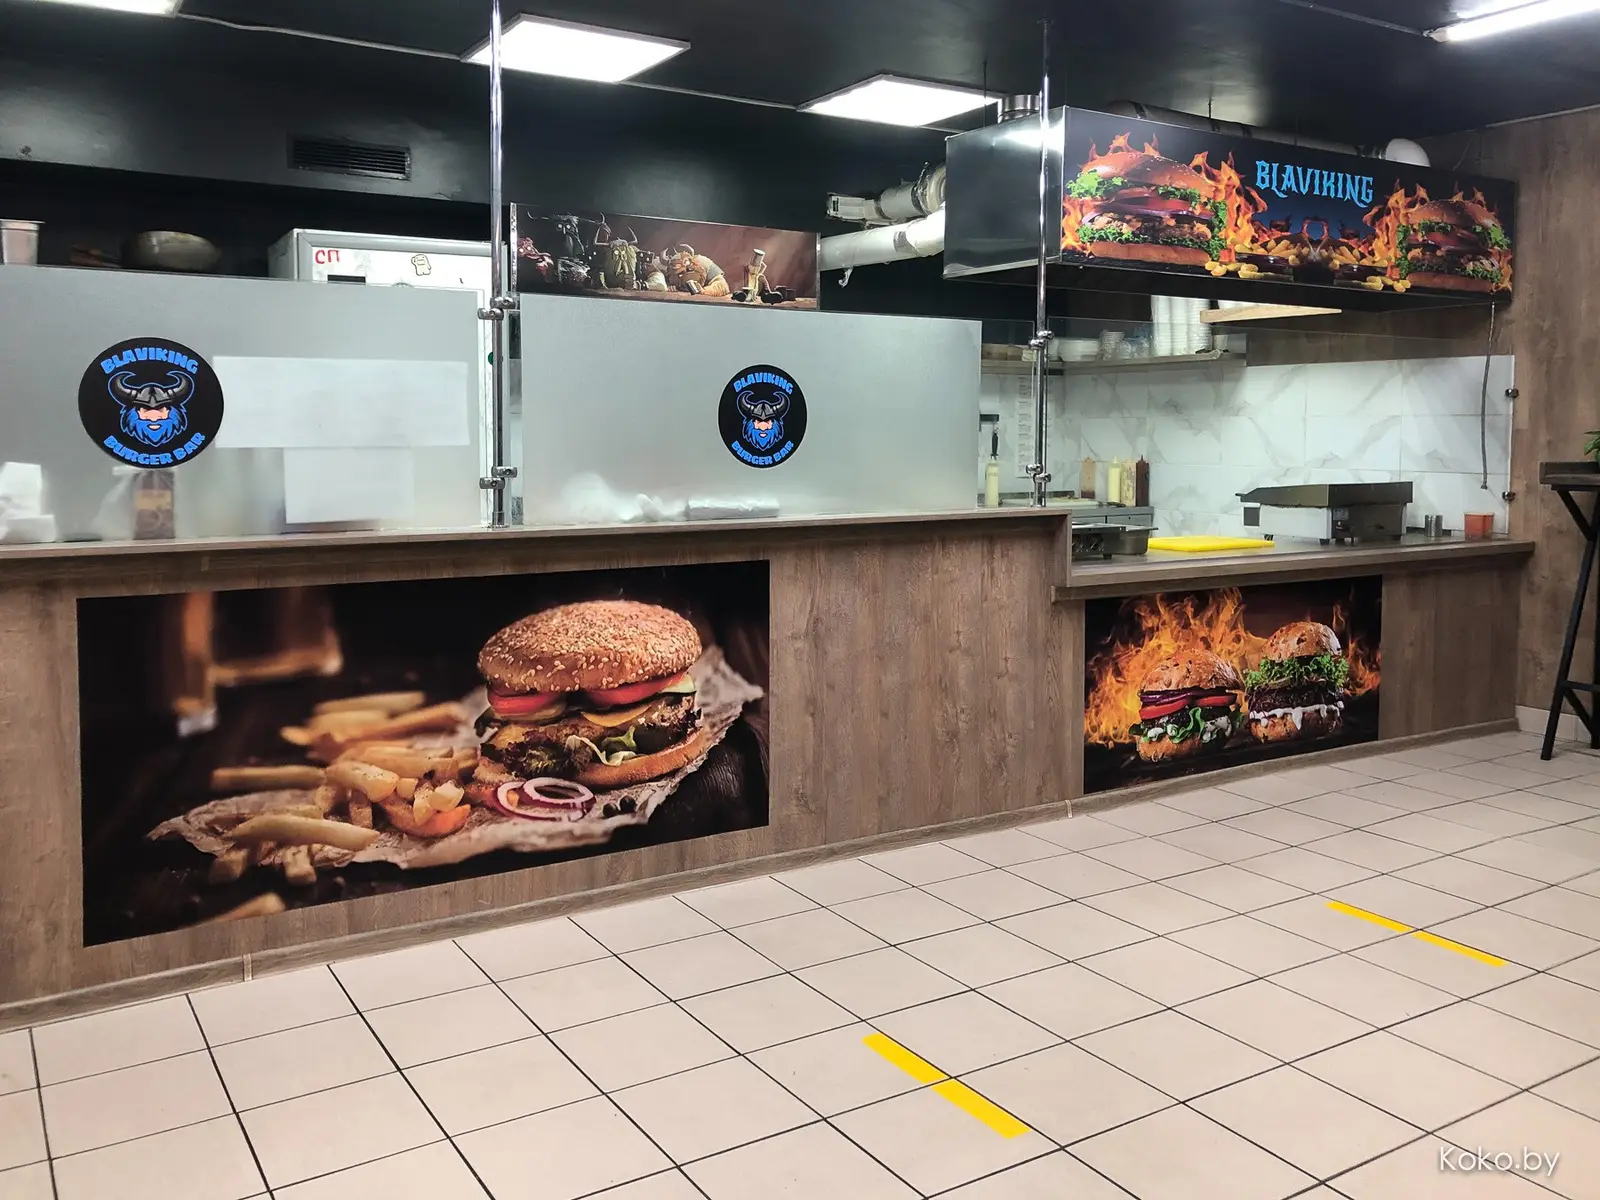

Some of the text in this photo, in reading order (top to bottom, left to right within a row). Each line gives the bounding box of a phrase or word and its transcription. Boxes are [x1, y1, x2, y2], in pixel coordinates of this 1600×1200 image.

[1255, 160, 1374, 208] BLAVIKING
[100, 347, 199, 374] BLAVIKING
[733, 372, 794, 395] BLAVIKING
[103, 432, 206, 465] BURGER BAR
[731, 440, 795, 465] BURGER BAR
